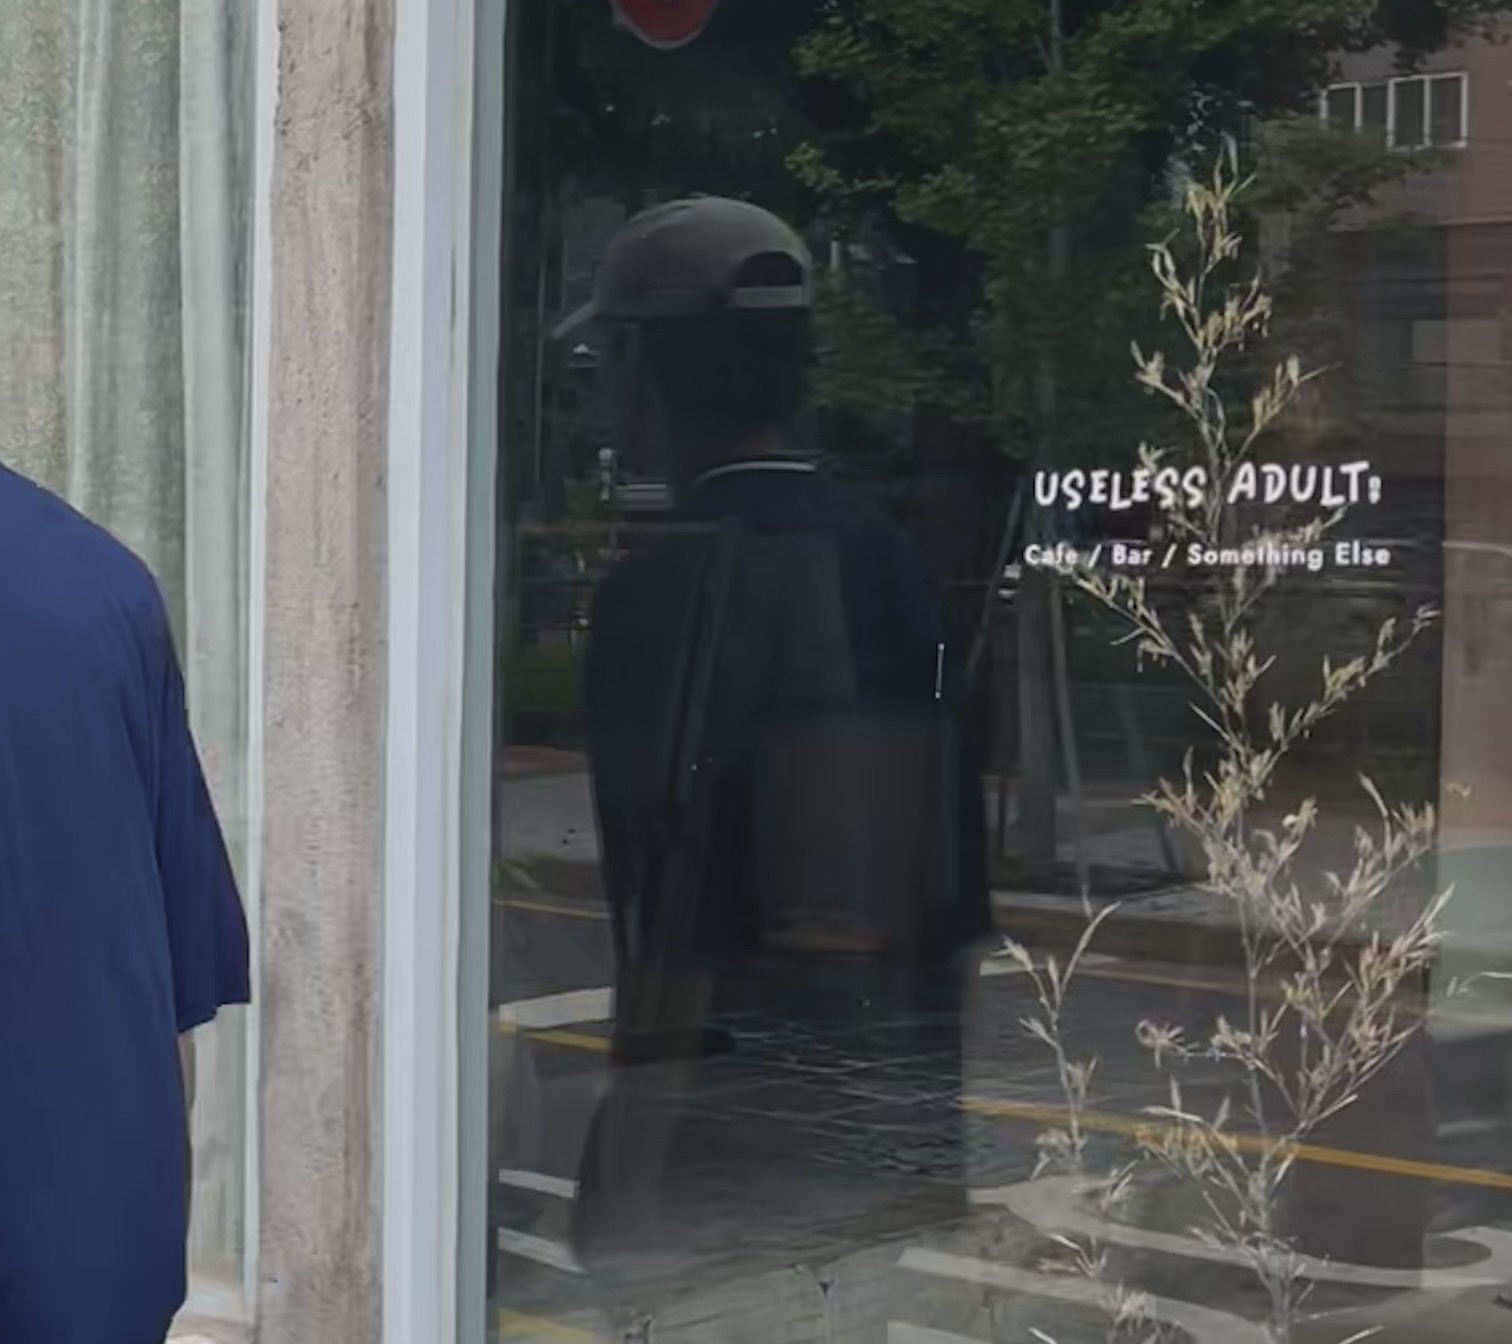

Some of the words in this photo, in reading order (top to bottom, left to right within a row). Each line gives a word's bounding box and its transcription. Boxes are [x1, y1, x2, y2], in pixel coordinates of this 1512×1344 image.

[1034, 466, 1208, 511] USELESS
[1024, 542, 1079, 565] Cafe
[1112, 543, 1152, 565] Bar
[1187, 542, 1324, 571] Something
[1335, 540, 1391, 566] Else
